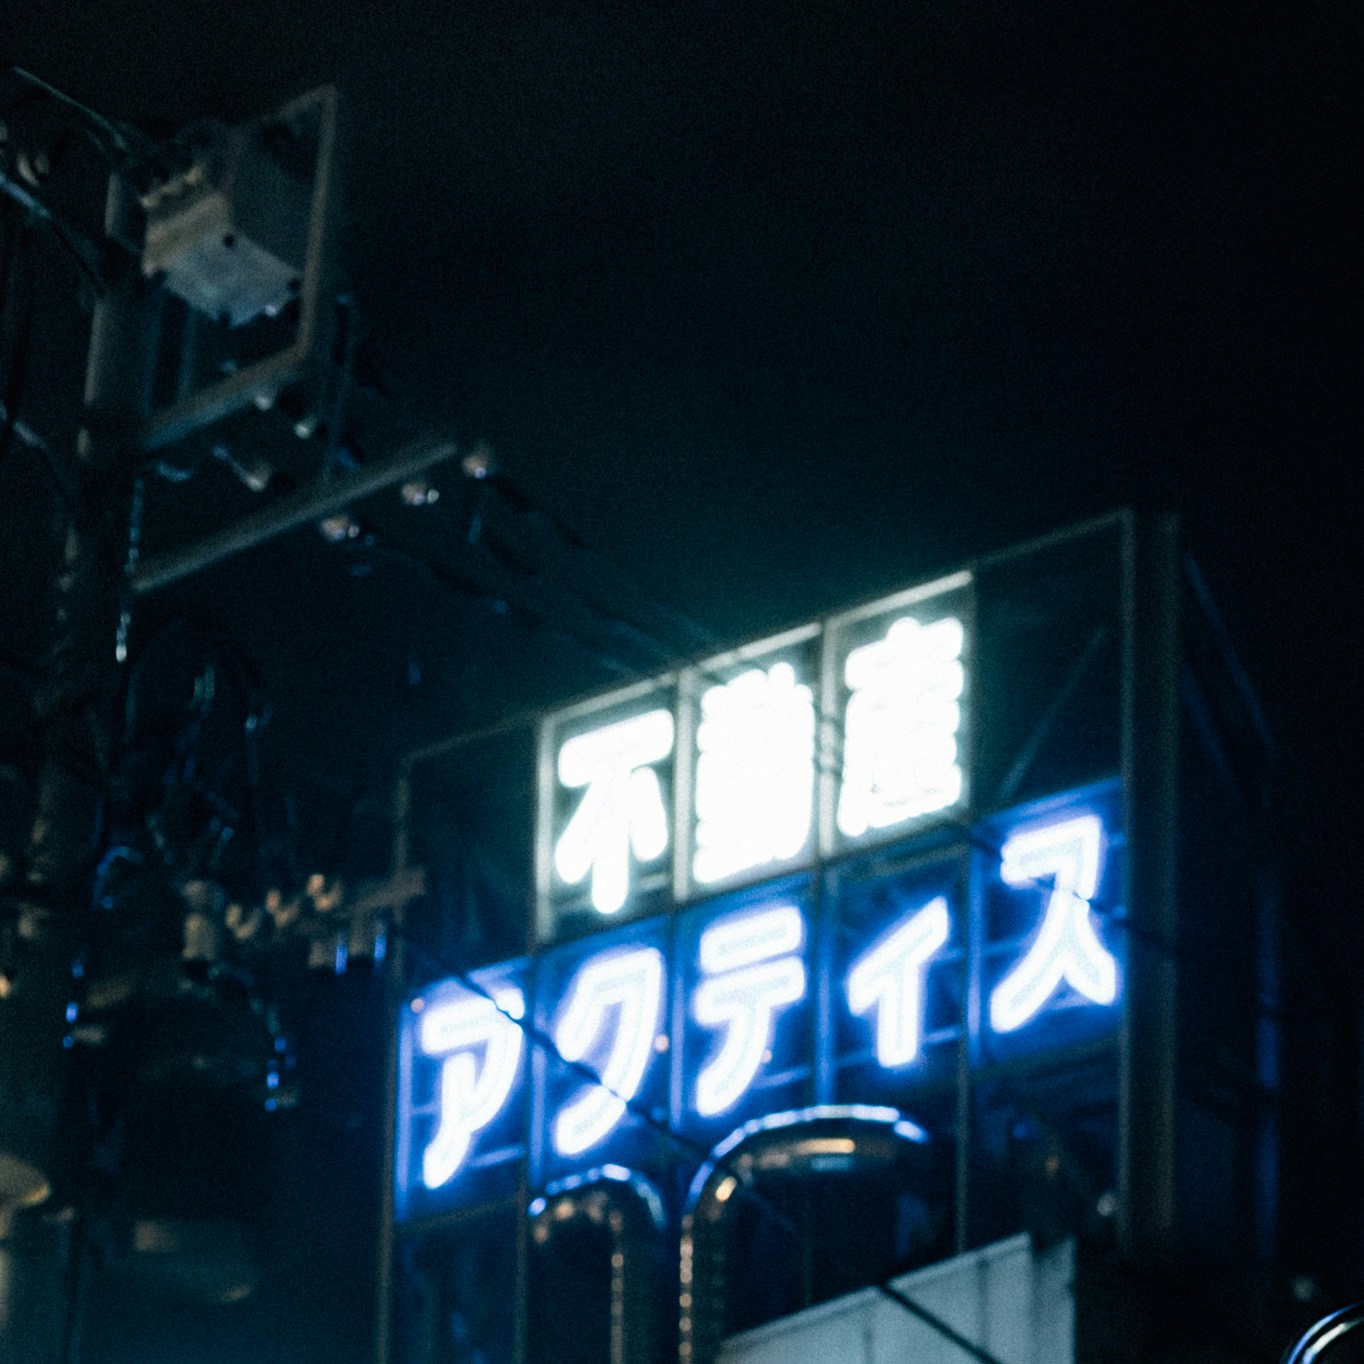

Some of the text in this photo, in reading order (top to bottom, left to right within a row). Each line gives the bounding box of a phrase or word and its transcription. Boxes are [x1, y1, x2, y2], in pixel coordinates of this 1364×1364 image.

[554, 617, 964, 914] 不動産
[421, 815, 1116, 1190] アクティス
